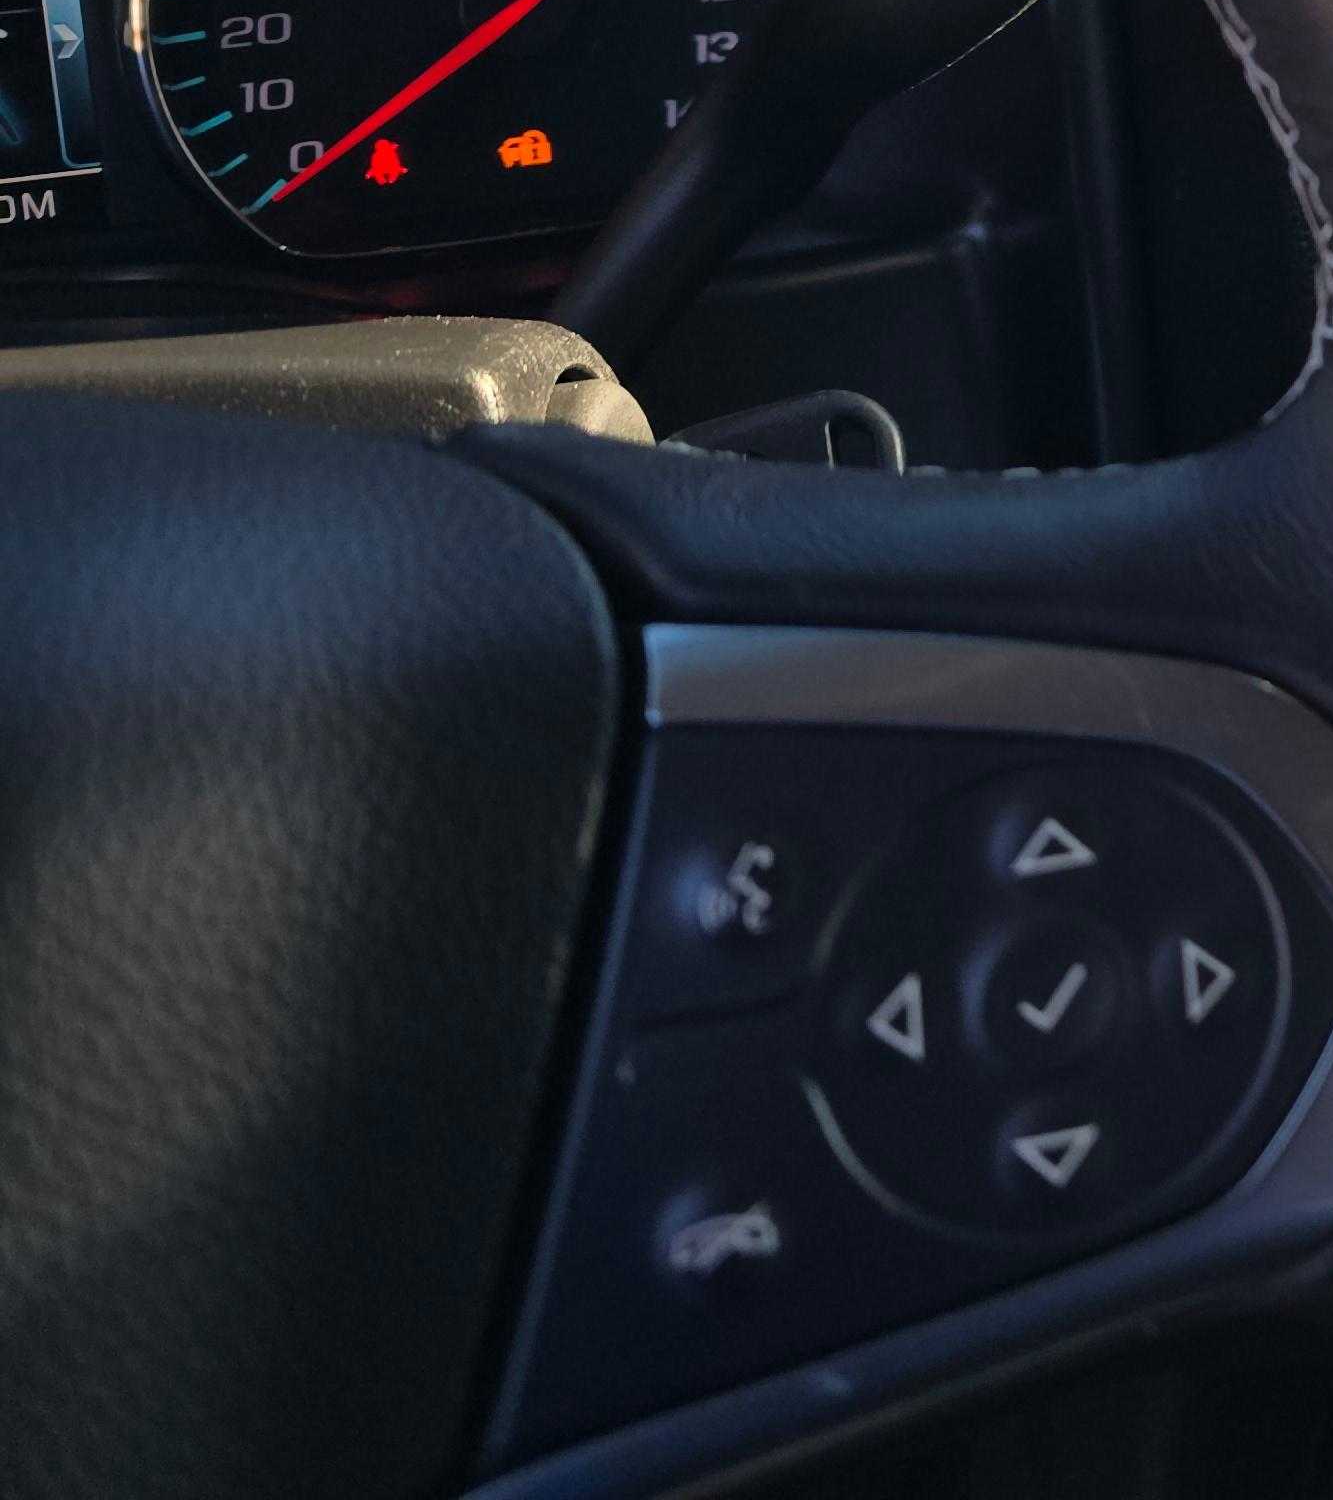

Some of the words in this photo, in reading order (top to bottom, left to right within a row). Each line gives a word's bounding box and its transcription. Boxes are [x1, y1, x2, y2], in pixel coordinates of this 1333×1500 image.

[220, 12, 292, 49] 20
[693, 31, 739, 64] 13
[240, 78, 295, 113] 10
[289, 140, 325, 173] 0
